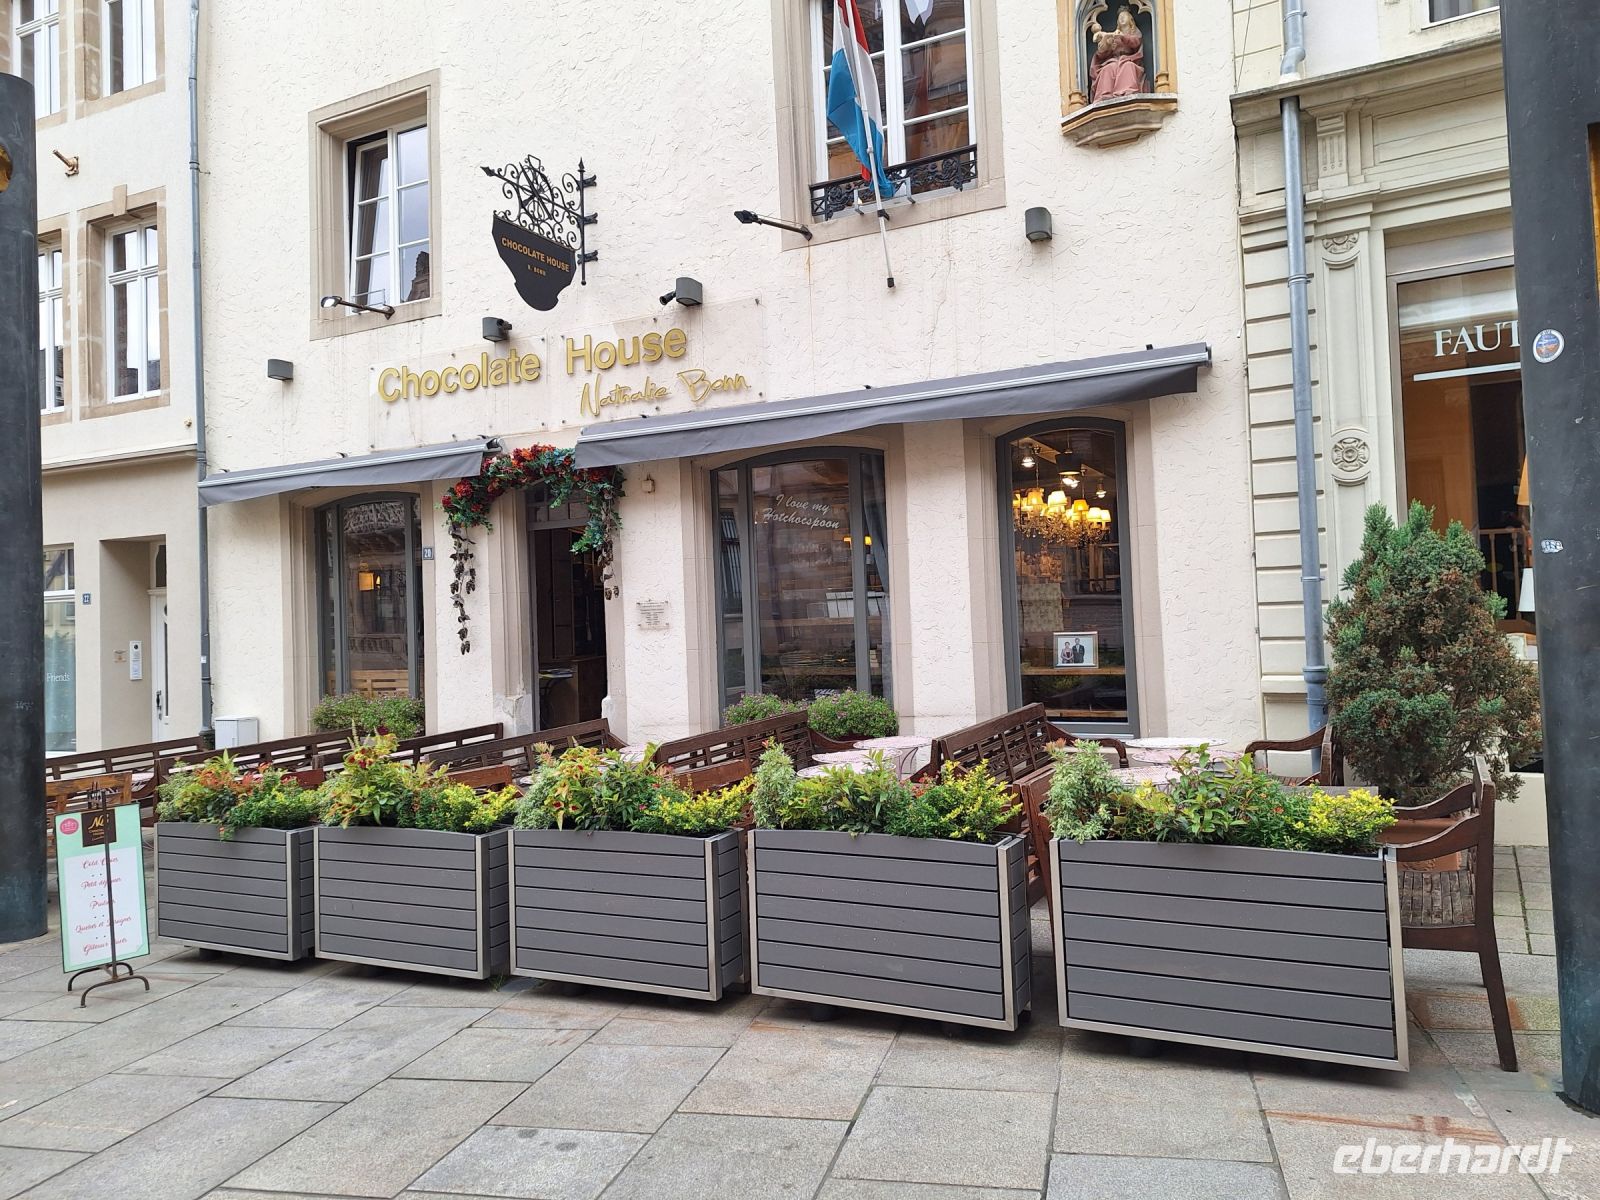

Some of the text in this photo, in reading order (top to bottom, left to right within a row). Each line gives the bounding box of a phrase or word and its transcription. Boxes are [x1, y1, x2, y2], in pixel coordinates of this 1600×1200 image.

[501, 237, 569, 273] CHOCOLATE HOUSE
[377, 328, 687, 402] Chocolate House
[580, 374, 670, 417] Nathalie
[776, 494, 830, 515] I love my
[424, 548, 432, 558] 20
[46, 671, 71, 682] Friends
